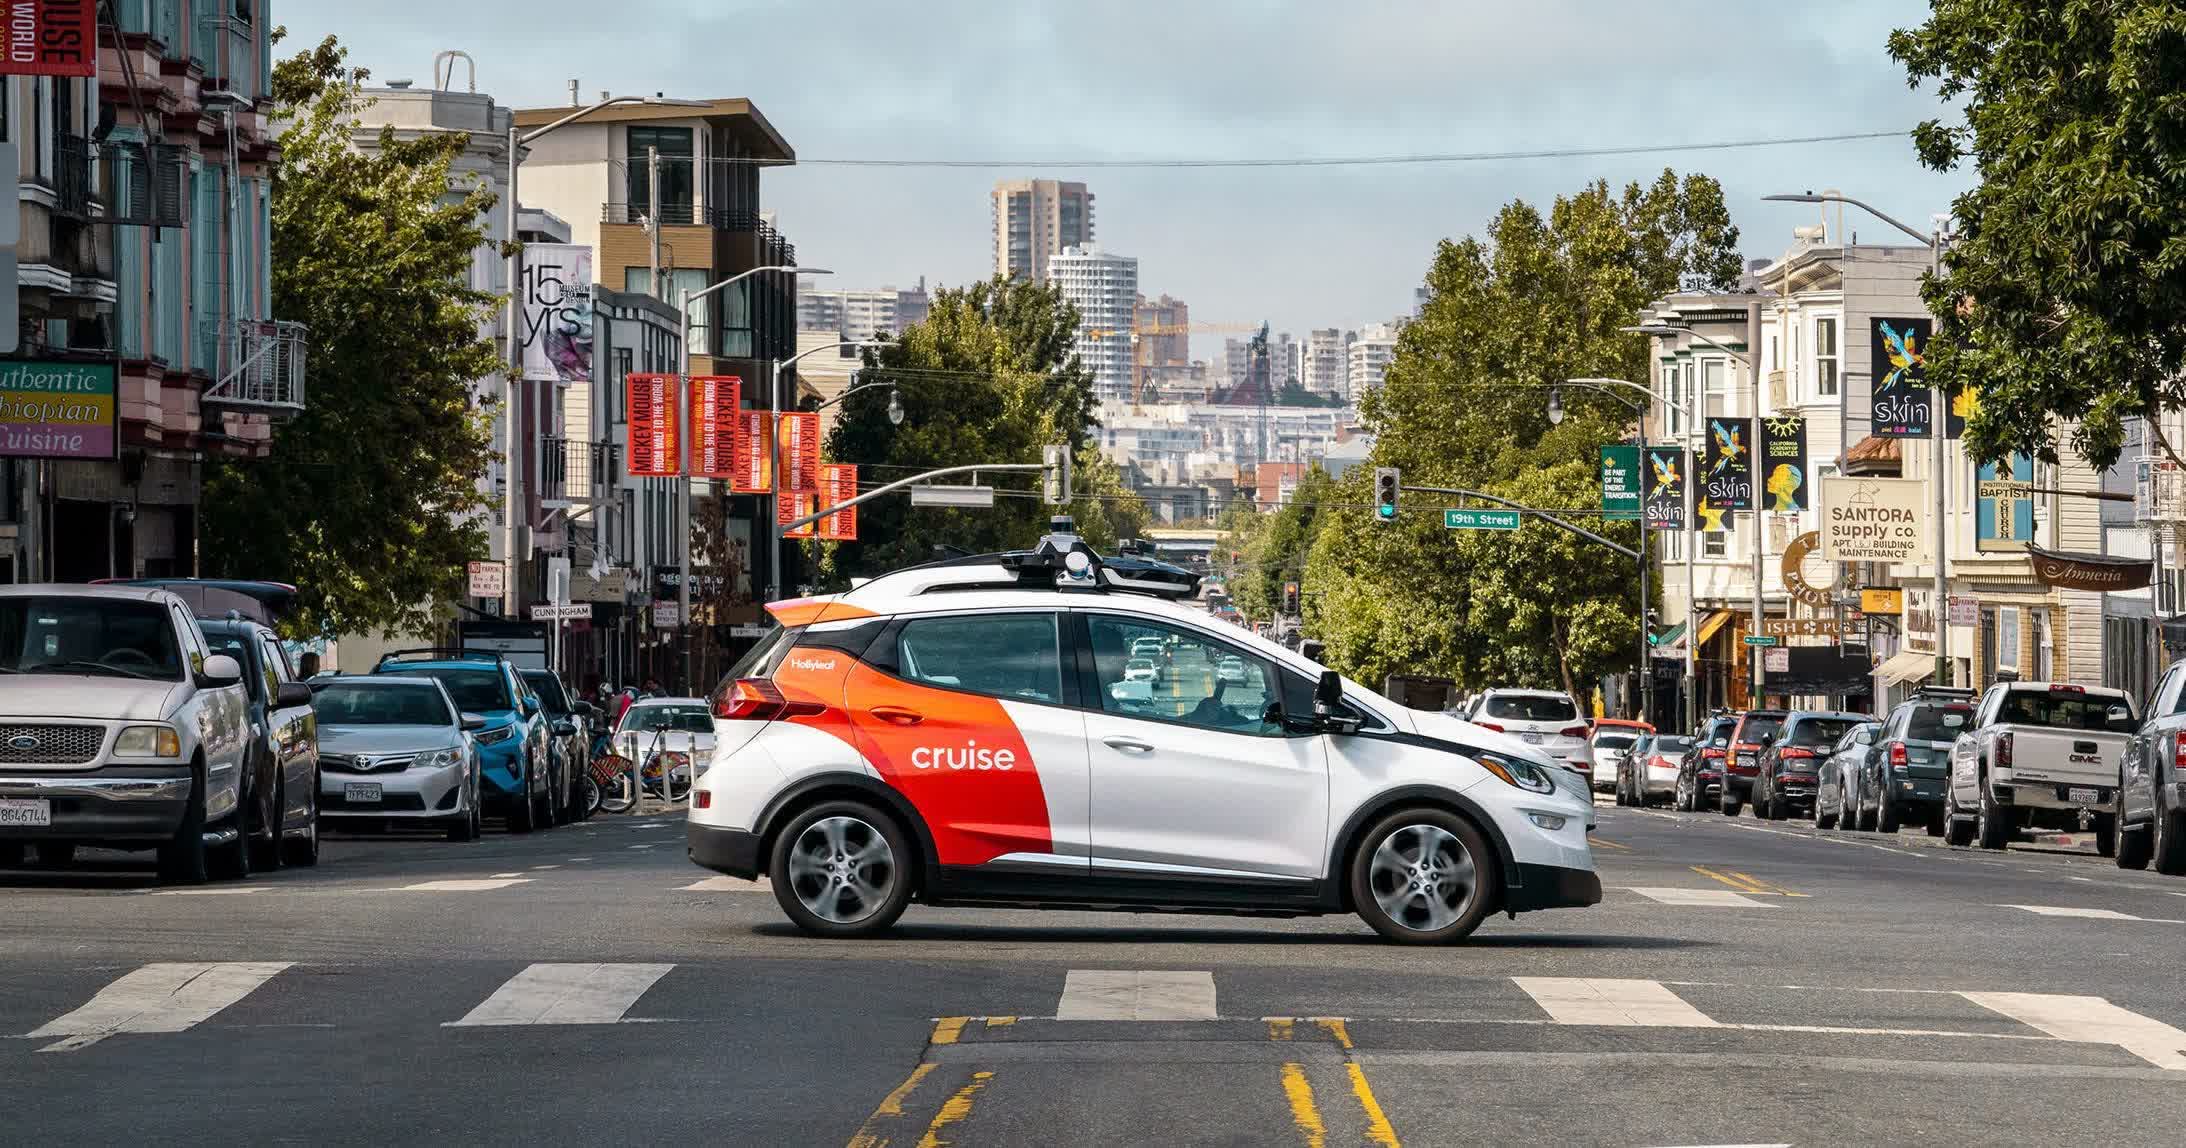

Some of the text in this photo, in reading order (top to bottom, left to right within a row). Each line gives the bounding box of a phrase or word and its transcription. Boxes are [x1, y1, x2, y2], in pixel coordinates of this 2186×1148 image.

[11, 2, 35, 62] WORLD
[41, 0, 81, 63] USE
[521, 263, 564, 306] 15
[560, 284, 590, 293] MUSEUM
[521, 306, 581, 348] yrs
[1874, 395, 1930, 423] skin
[633, 378, 651, 471] MICKEY MOUSE
[652, 377, 665, 472] FROM WALT TO THE WORLD
[704, 380, 715, 472] FROM WALT TO THE WORLD
[717, 381, 734, 472] MICKEY MOUSE
[802, 417, 816, 454] MICKEY
[736, 415, 751, 488] MICKEY MOUSE
[801, 455, 816, 489] MOUSE
[1708, 476, 1750, 498] skin
[1980, 488, 2028, 498] BAPTIST
[778, 496, 793, 528] ICKEY
[840, 507, 852, 536] OUSE
[1452, 514, 1514, 525] 19th Street
[1647, 501, 1684, 520] skin
[1832, 507, 1915, 522] SANTORA
[2000, 499, 2009, 539] CHURCH
[1832, 523, 1888, 540] supply
[1832, 539, 1851, 548] APT.
[1873, 540, 1915, 549] BUILDING
[1838, 548, 1908, 558] MAINTENANCE
[2043, 562, 2122, 584] Amnesia
[534, 607, 589, 617] CUNNNGHAM
[791, 658, 836, 671] Hollyleaf
[911, 739, 1016, 770] cruise
[2069, 754, 2102, 764] GMC
